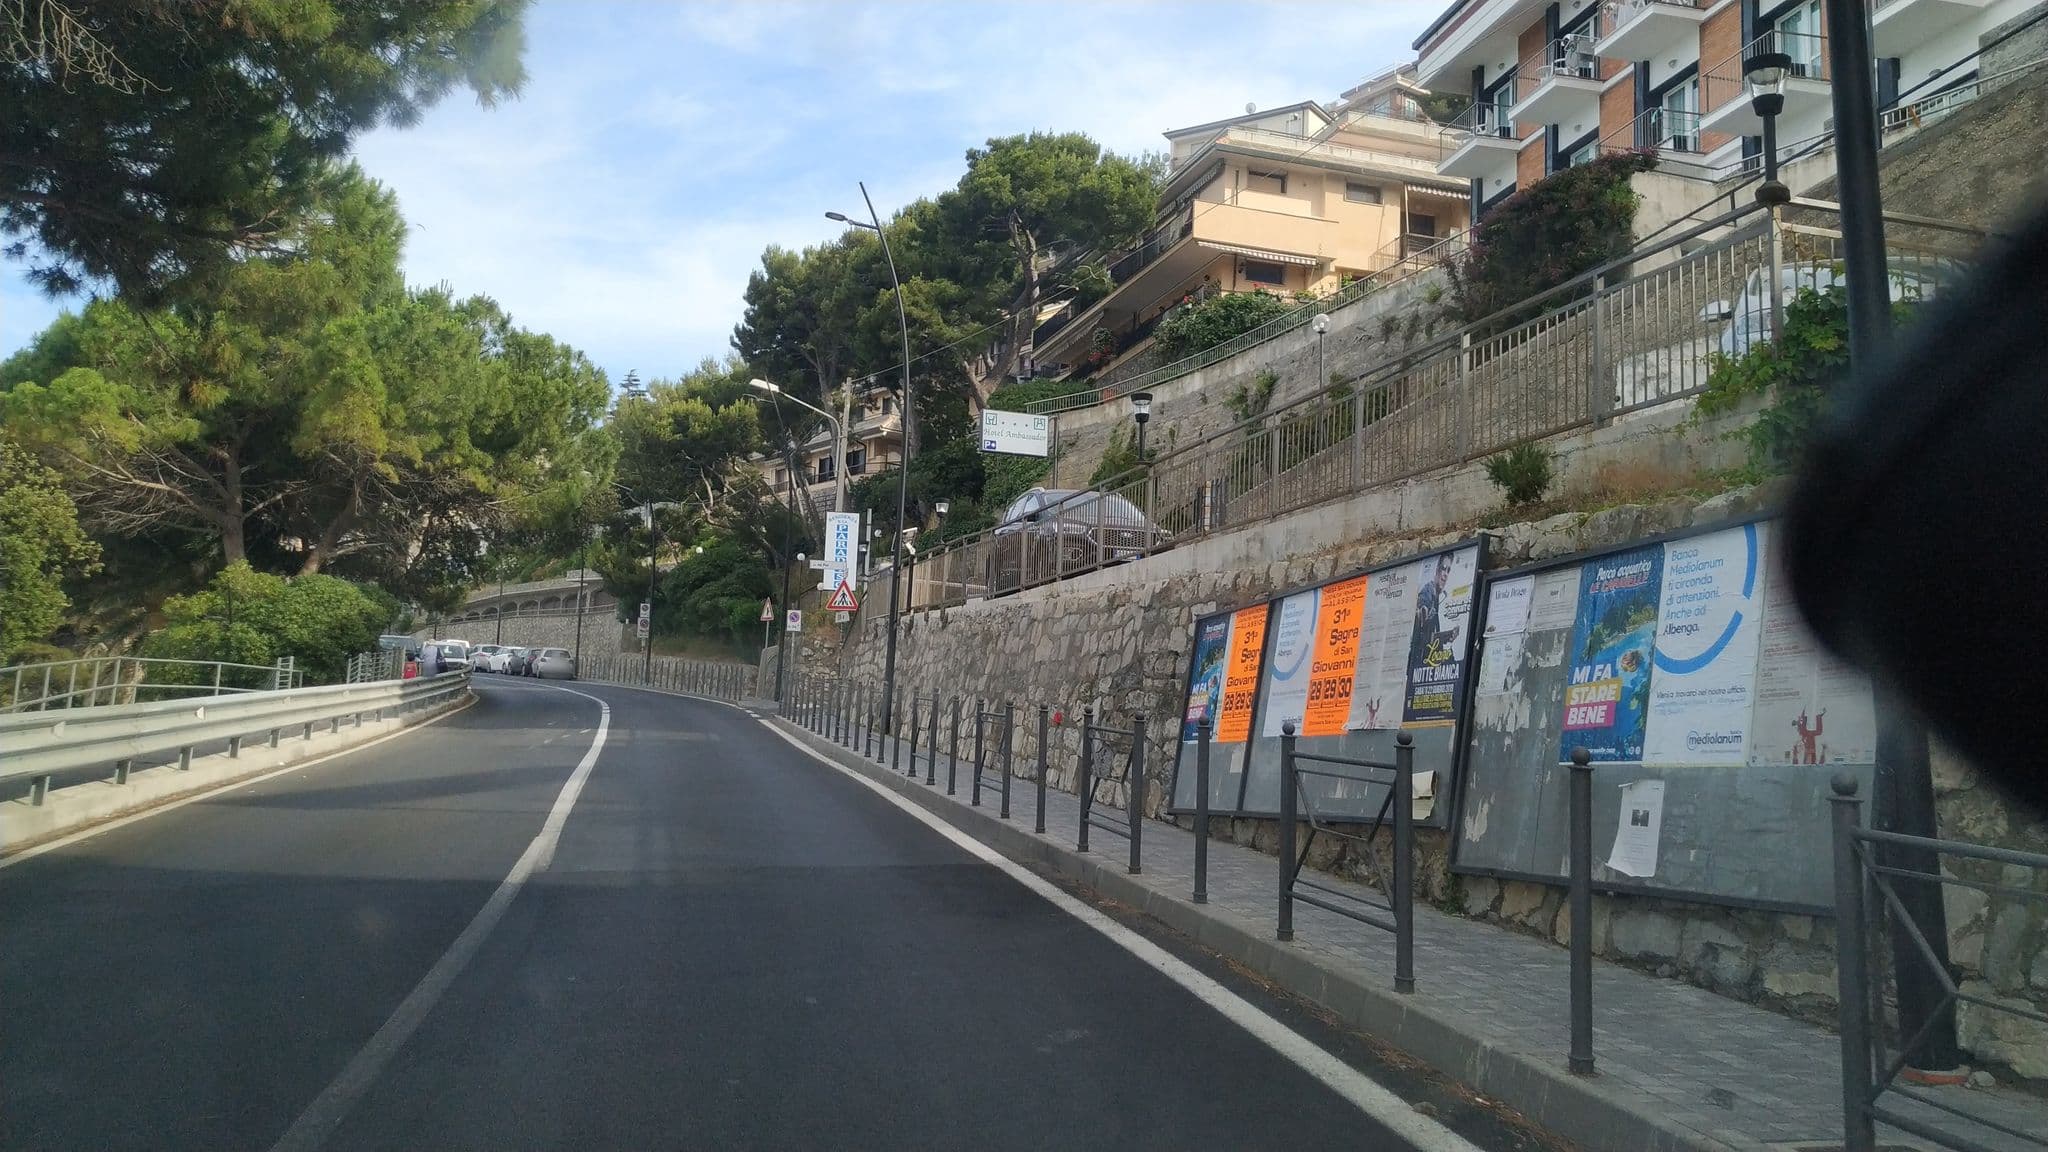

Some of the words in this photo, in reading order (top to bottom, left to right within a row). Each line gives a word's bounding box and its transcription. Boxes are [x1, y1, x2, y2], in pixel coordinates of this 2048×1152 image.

[984, 428, 1004, 438] Hotel
[1672, 549, 1698, 561] Banca
[1596, 567, 1617, 581] Parco
[1617, 559, 1652, 577] acquatico
[1670, 558, 1724, 576] Mediolanum
[1675, 574, 1713, 590] circonda
[1665, 607, 1692, 620] Anche
[1694, 604, 1706, 616] ad
[1330, 627, 1359, 646] Sagra
[1340, 646, 1353, 655] San
[1423, 638, 1453, 667] Loano
[1312, 656, 1355, 673] Giovanni
[1412, 666, 1433, 683] NOTTE
[1434, 664, 1460, 681] BIANCA
[1572, 665, 1591, 685] MI
[1592, 663, 1612, 682] FA
[1310, 681, 1322, 700] 28
[1324, 679, 1337, 699] 29
[1338, 677, 1352, 698] 30
[1570, 683, 1618, 706] STARE
[1566, 705, 1607, 725] BENE
[1688, 731, 1742, 745] mediolanum
